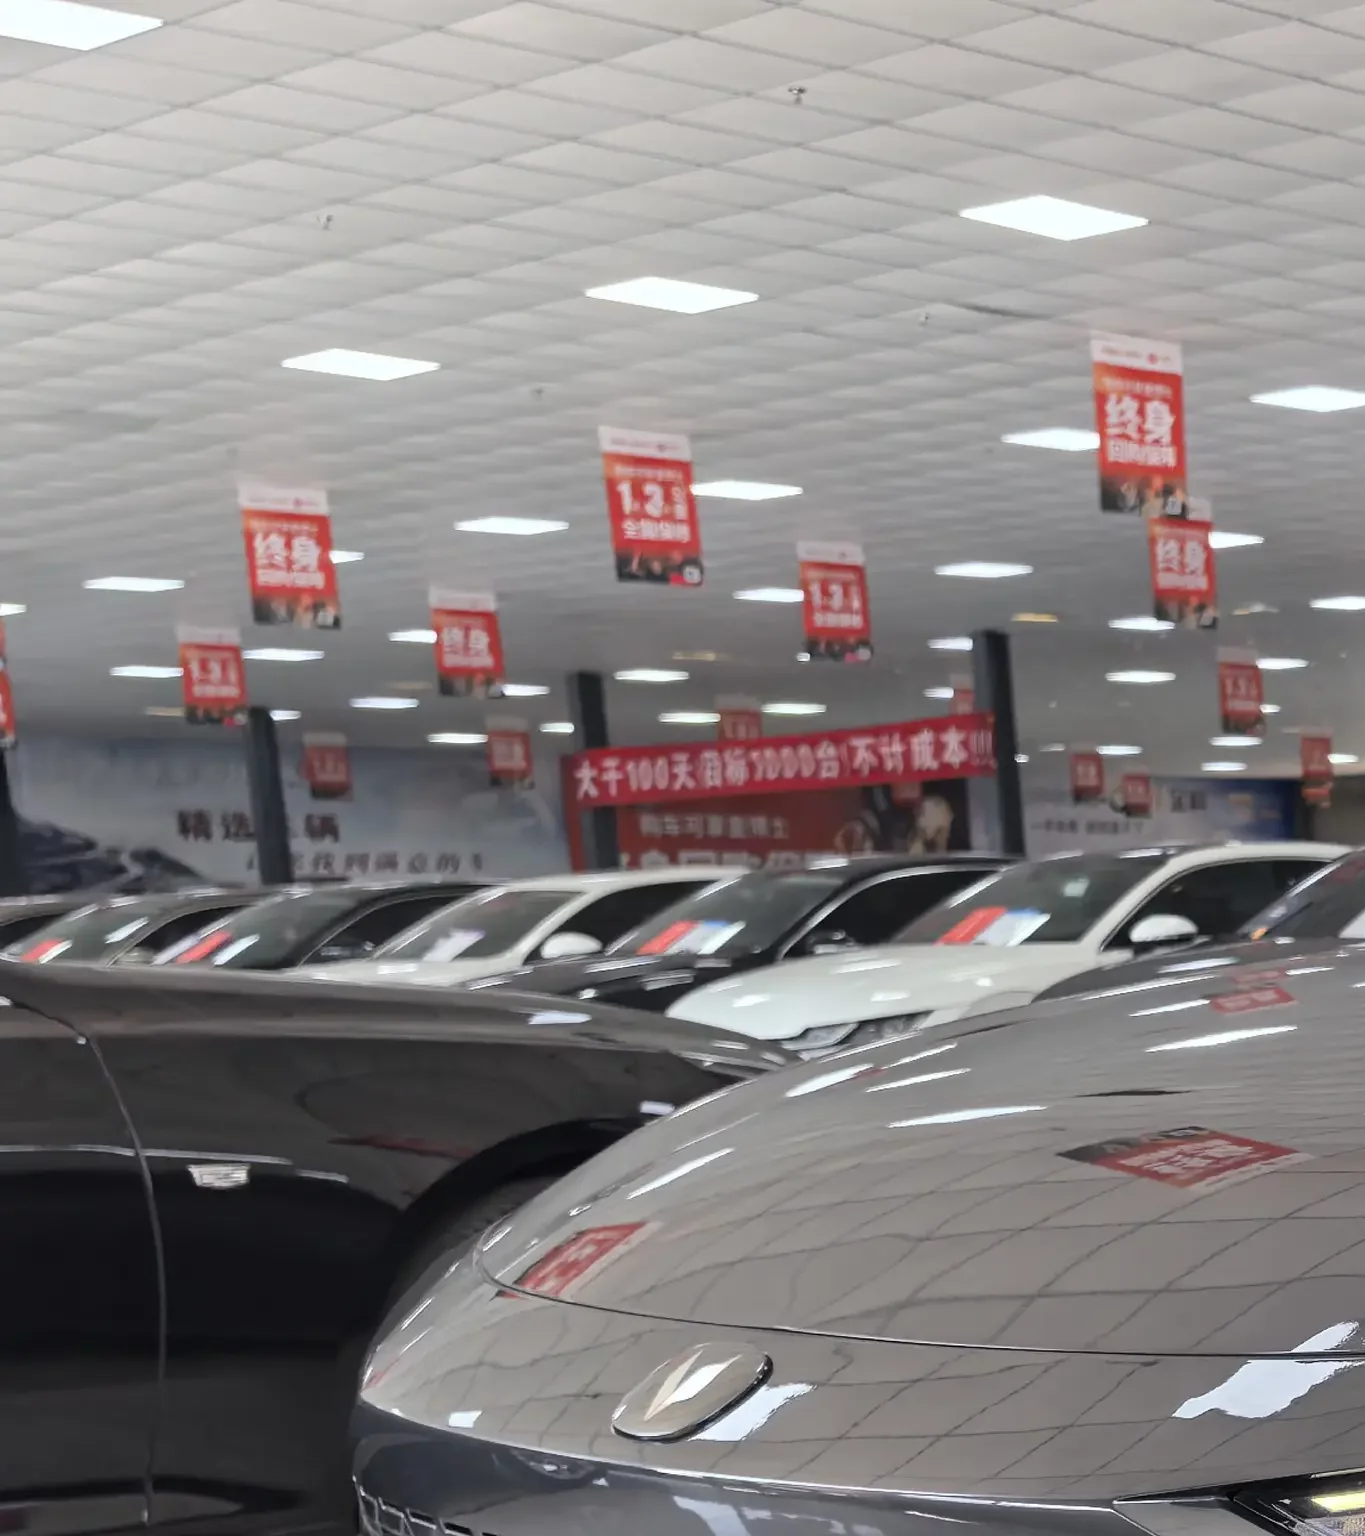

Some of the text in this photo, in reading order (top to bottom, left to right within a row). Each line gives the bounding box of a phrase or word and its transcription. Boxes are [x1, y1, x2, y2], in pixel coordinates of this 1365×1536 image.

[1105, 393, 1176, 447] 终身
[254, 531, 322, 573] 终身
[176, 810, 341, 844] 精选辆
